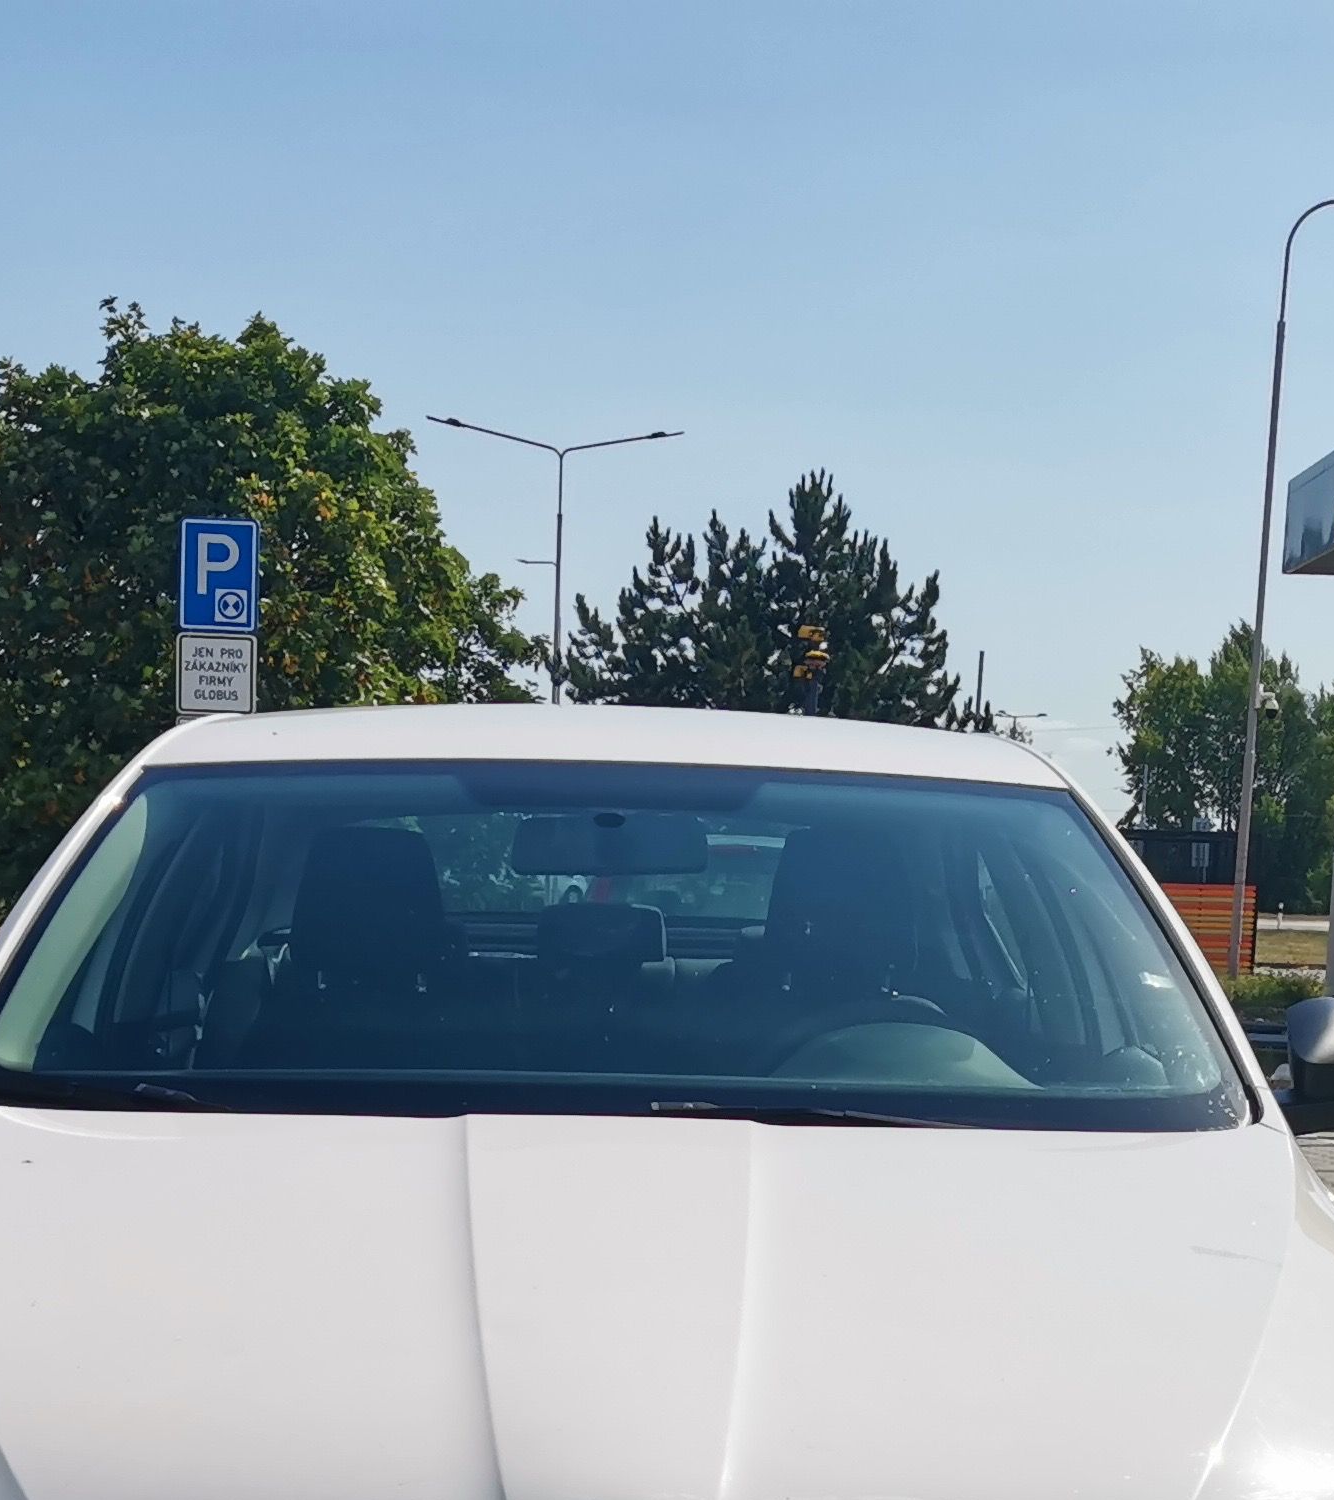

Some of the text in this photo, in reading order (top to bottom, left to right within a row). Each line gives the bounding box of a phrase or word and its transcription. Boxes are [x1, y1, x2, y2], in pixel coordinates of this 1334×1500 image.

[197, 532, 240, 595] P
[192, 647, 243, 659] JEN PRO
[184, 659, 248, 673] ZÁKAZNÍKY
[198, 675, 234, 687] FIRMY
[194, 689, 238, 701] GLOBUS
